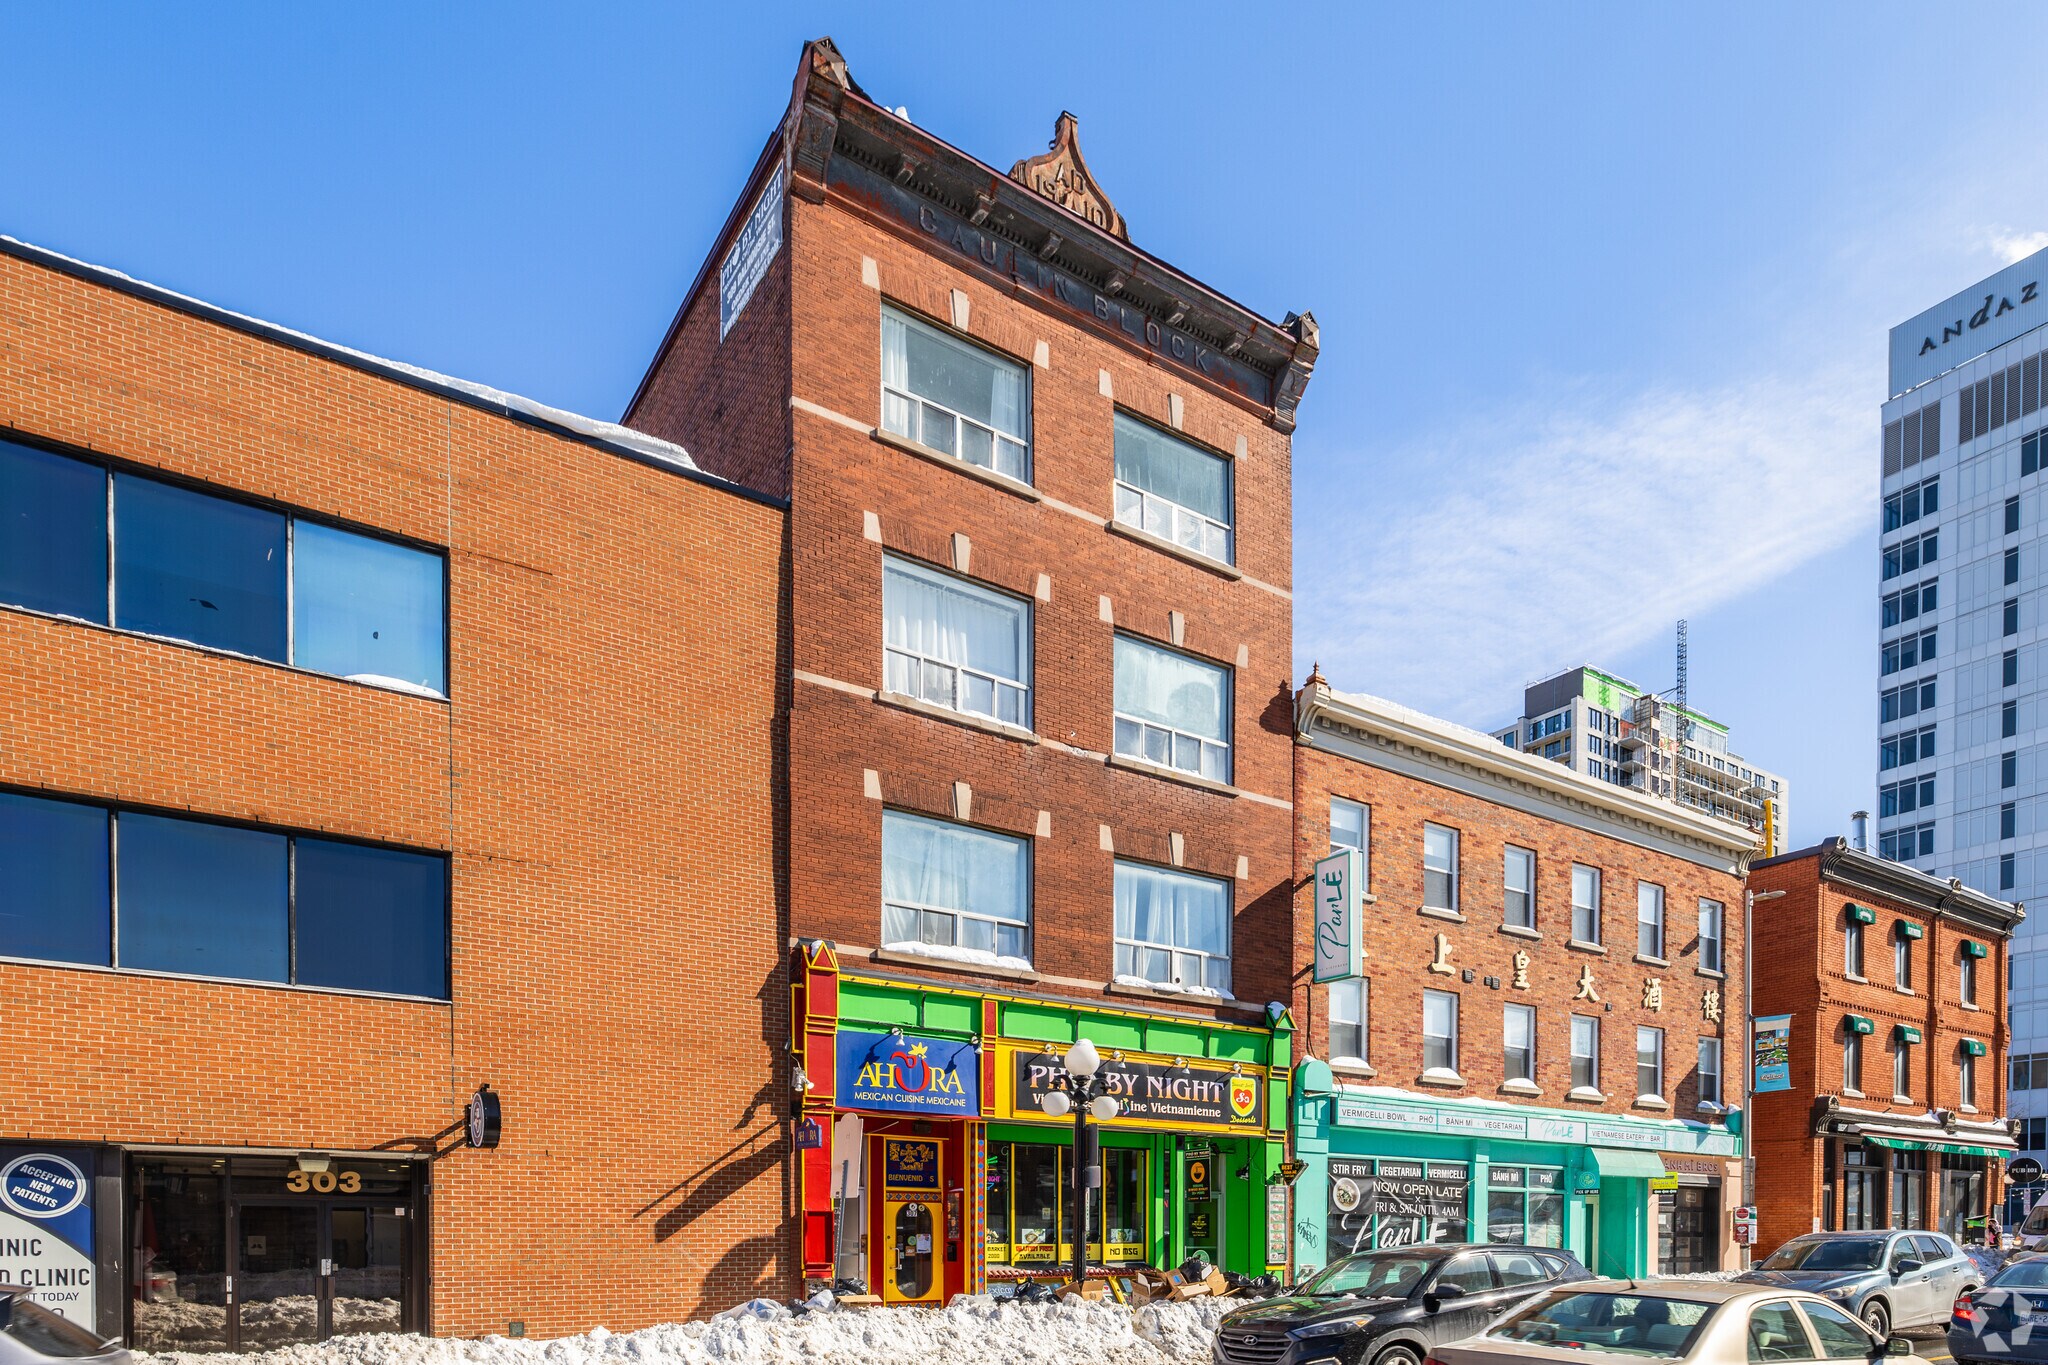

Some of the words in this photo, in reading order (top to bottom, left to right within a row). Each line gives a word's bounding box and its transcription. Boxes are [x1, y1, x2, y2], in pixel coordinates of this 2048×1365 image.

[755, 170, 781, 227] NIGHT
[1094, 293, 1209, 372] BLOCK
[1362, 933, 1721, 1024] 上皇大酒樓
[1104, 1072, 1139, 1096] BY
[1146, 1075, 1225, 1103] NIGHT
[854, 1092, 893, 1102] MEXICAN
[895, 1095, 924, 1104] CUISINE
[926, 1097, 966, 1107] MEXICAINE
[1150, 1102, 1221, 1117] Vietnamienne
[1341, 1109, 1385, 1120] VERMICELLI
[1387, 1112, 1407, 1121] BOWL
[1484, 1121, 1523, 1131] VEGETARIAN
[1591, 1130, 1625, 1140] VIETNAMESE
[1626, 1133, 1645, 1141] EATERY
[20, 1164, 75, 1190] ACCEPTING
[1332, 1164, 1350, 1174] STIR
[1352, 1165, 1367, 1175] FRY
[1380, 1166, 1421, 1177] VEGETARIAN
[1428, 1168, 1466, 1179] VERMICELLI
[286, 1169, 362, 1193] 303
[888, 1173, 934, 1183] BIENVENIDS
[29, 1179, 54, 1194] NEW
[1373, 1181, 1400, 1193] NOW
[1403, 1184, 1433, 1196] OPEN
[1436, 1187, 1462, 1198] LATE
[11, 1186, 58, 1208] PATIENTS
[1375, 1201, 1388, 1212] FRI
[1389, 1203, 1397, 1213] &
[1415, 1204, 1439, 1216] UNTIL
[1442, 1206, 1459, 1216] 4AM
[21, 1268, 90, 1287] CLINIC
[40, 1292, 79, 1301] TODAY
